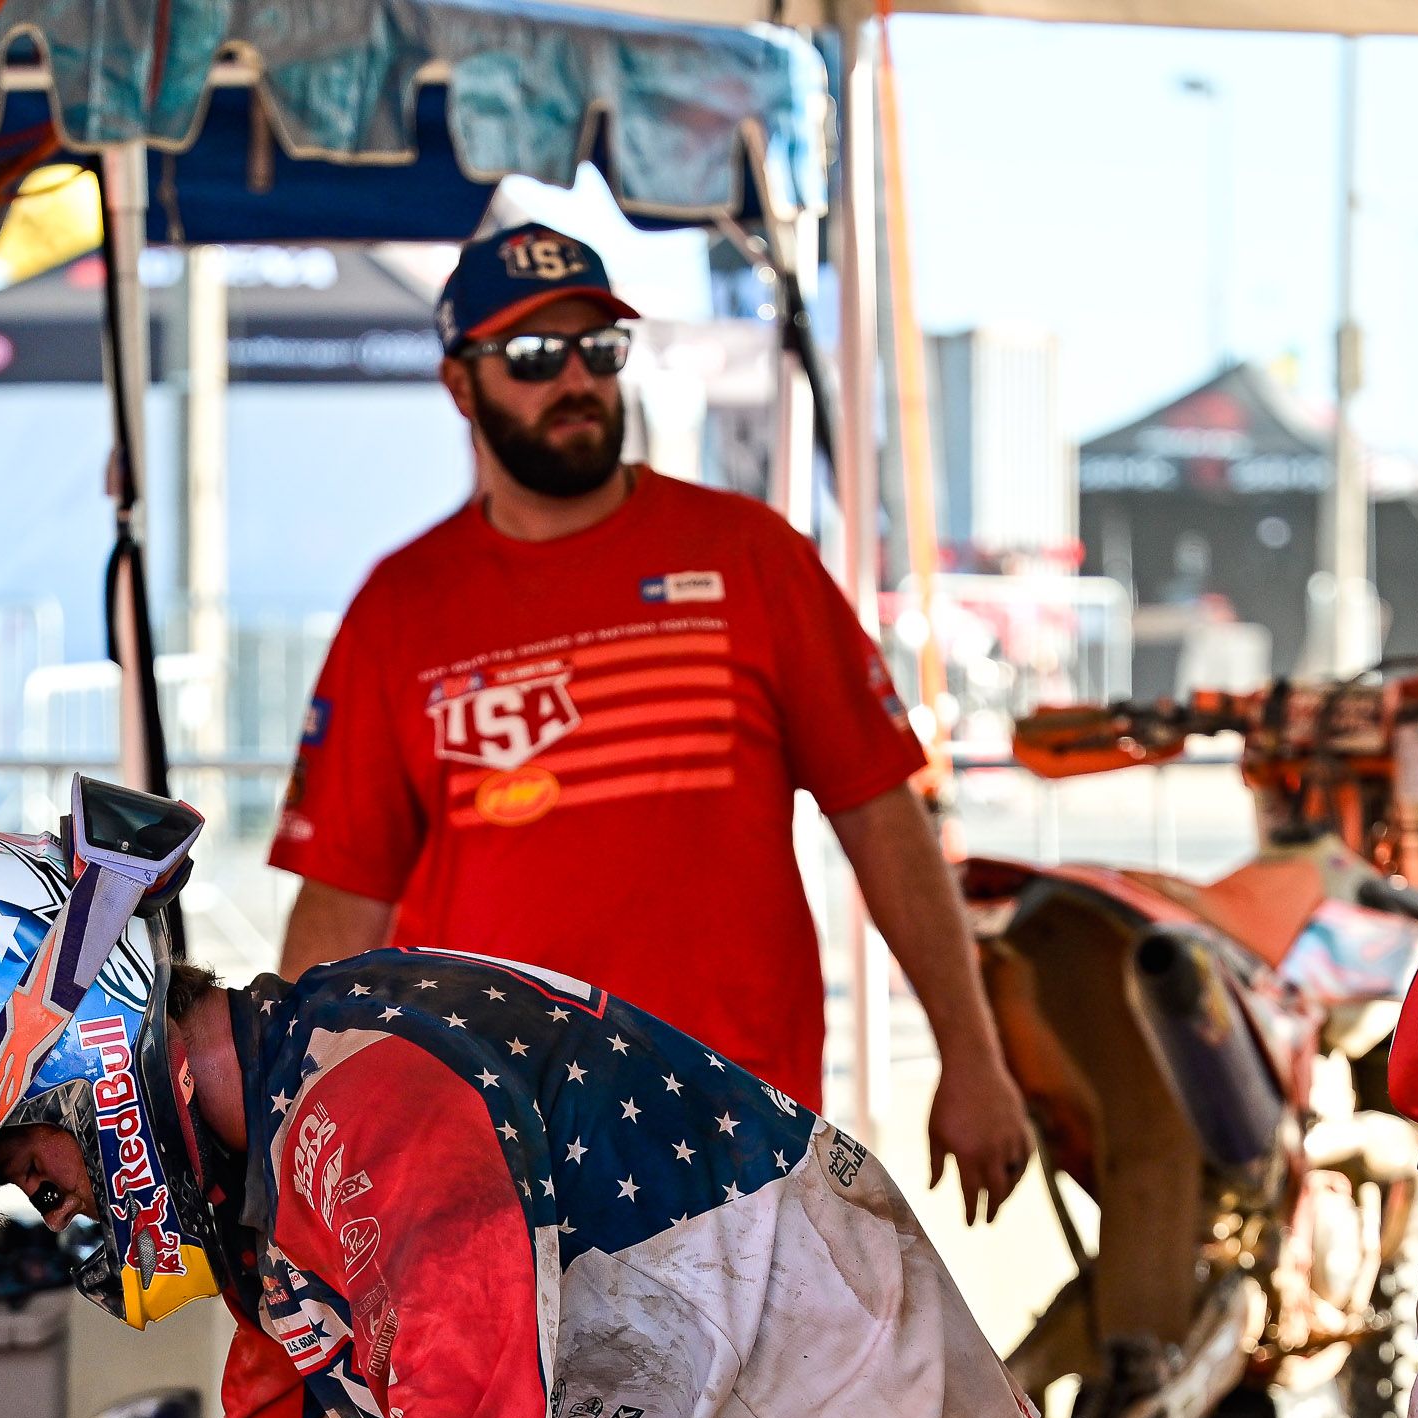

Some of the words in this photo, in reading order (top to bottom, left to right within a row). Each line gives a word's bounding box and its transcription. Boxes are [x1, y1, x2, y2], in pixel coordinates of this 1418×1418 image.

[77, 1014, 138, 1112] Bull
[98, 1107, 156, 1199] Red
[299, 1331, 318, 1350] 6DAY
